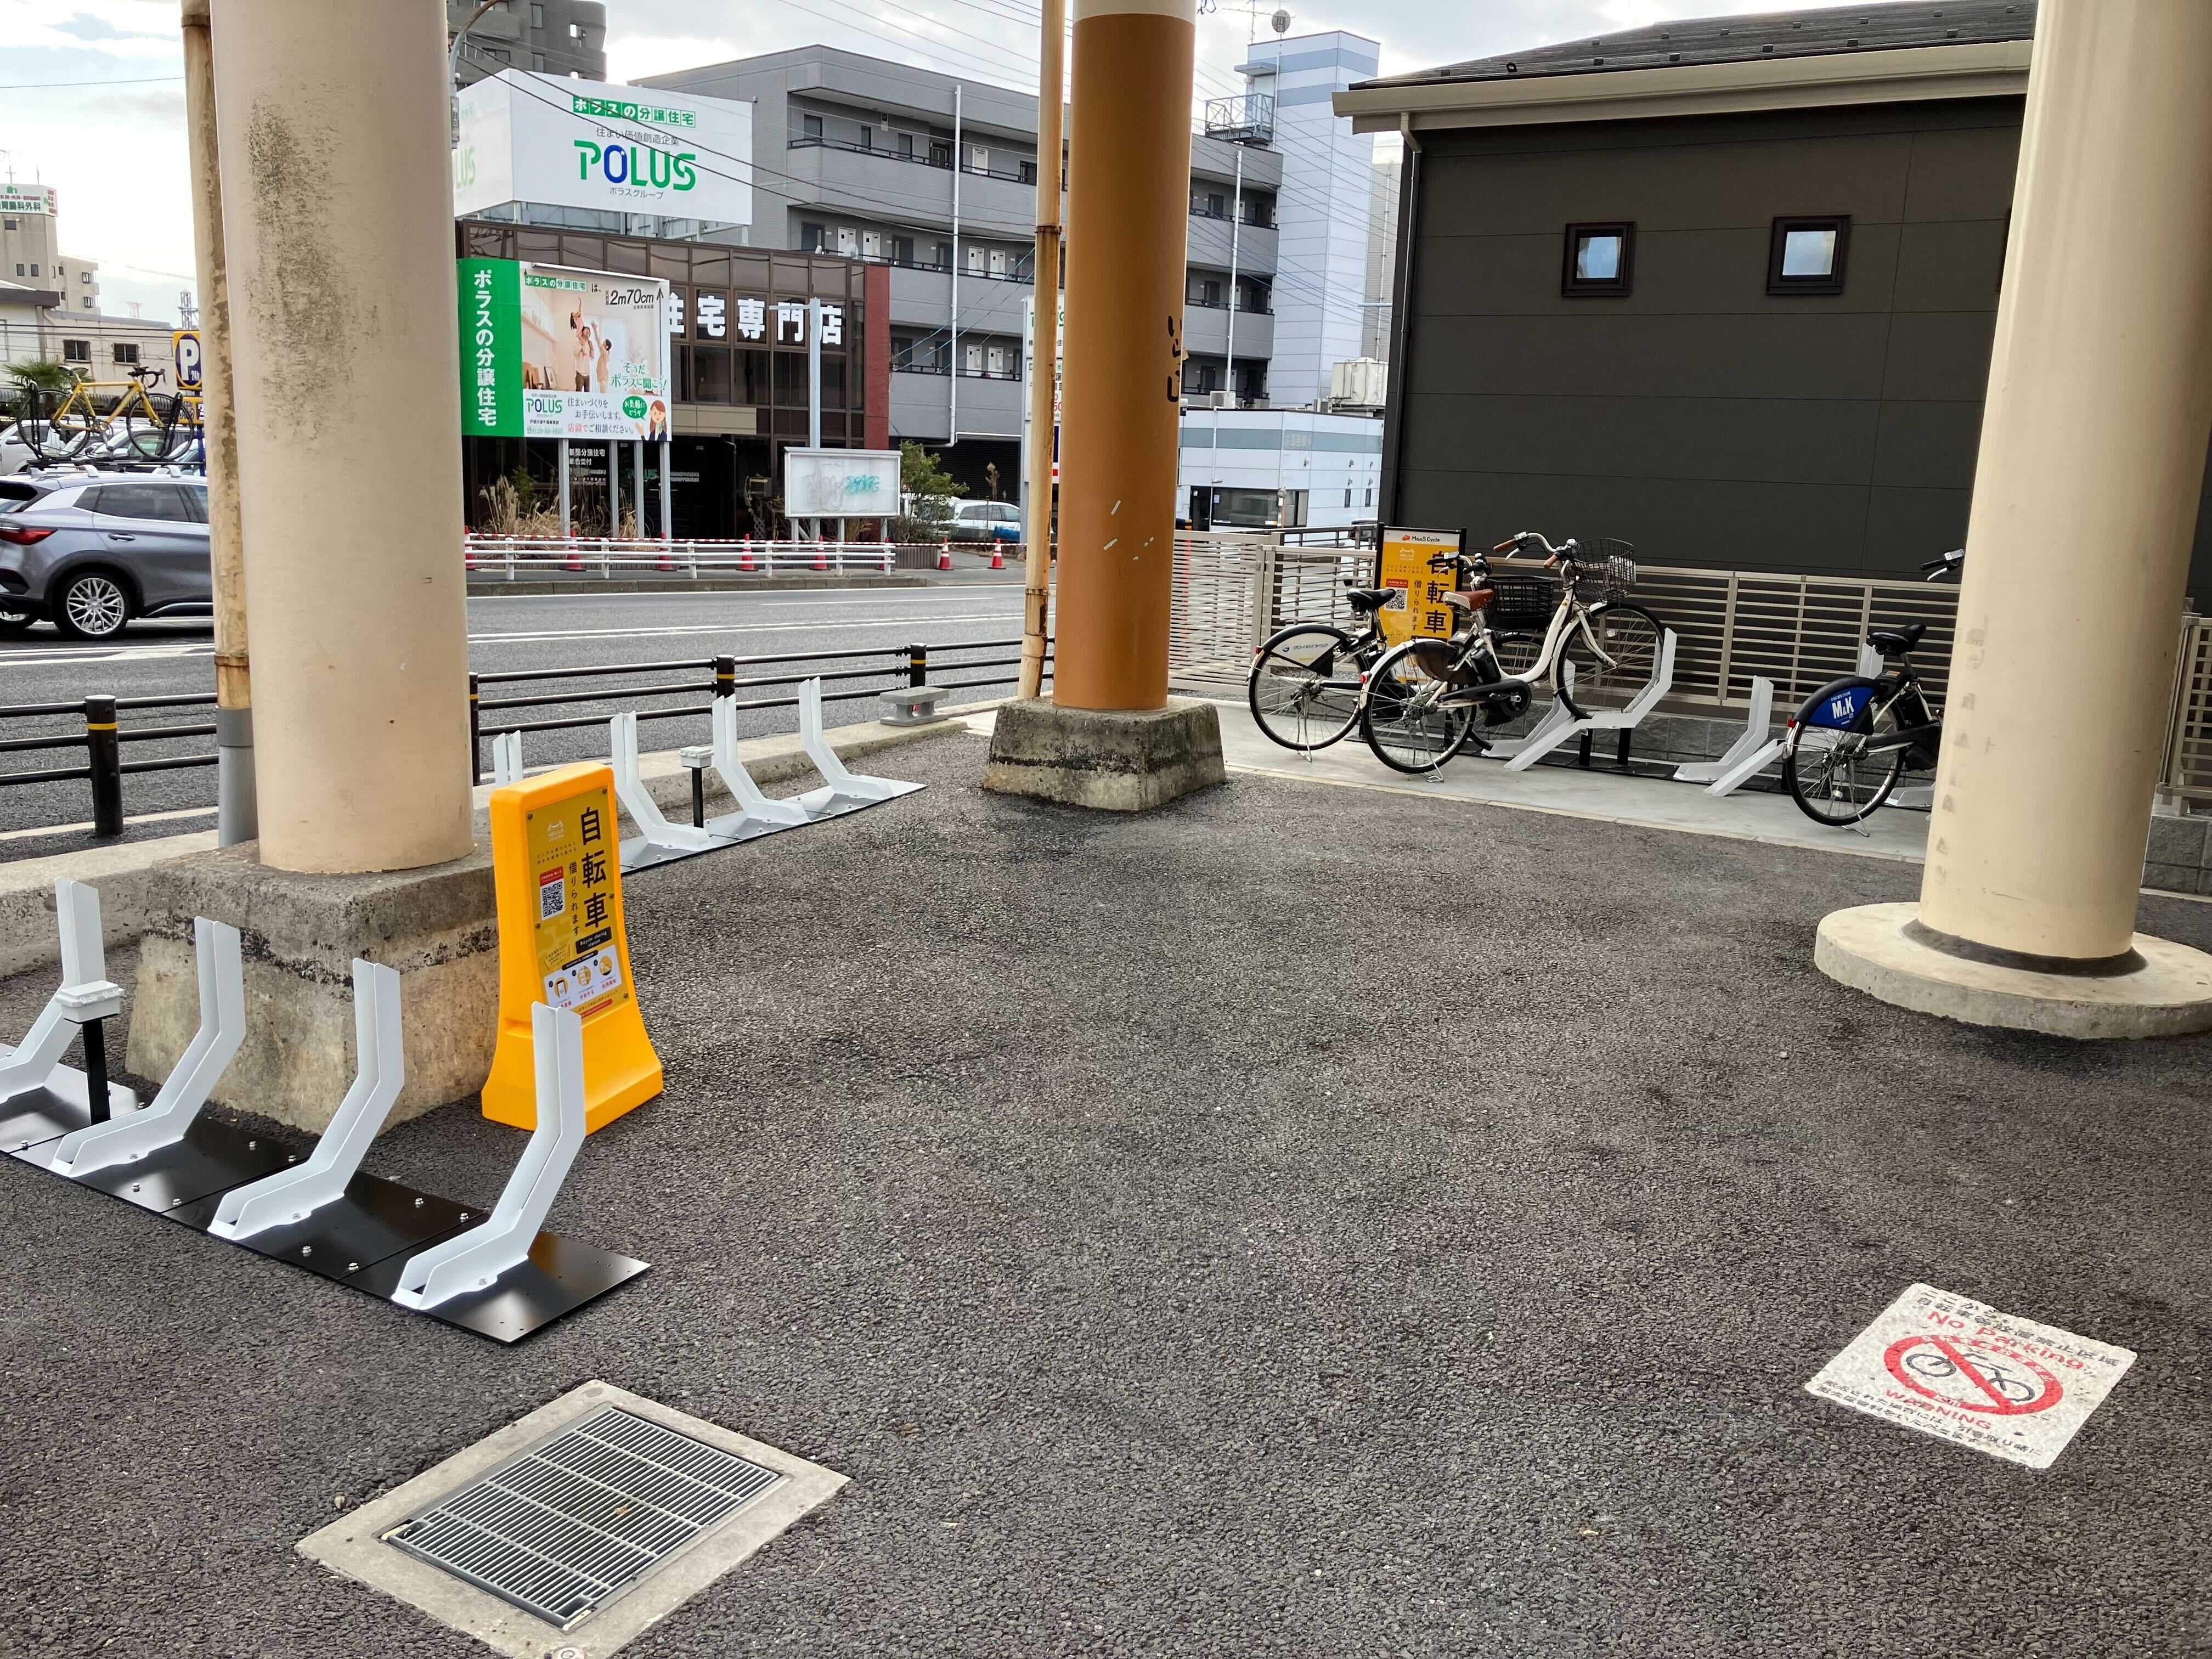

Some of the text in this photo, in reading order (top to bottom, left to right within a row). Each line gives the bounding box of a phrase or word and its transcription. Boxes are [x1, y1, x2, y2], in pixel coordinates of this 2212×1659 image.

[574, 97, 694, 126] ポラスの分譲住宅
[596, 127, 680, 146] 住まい価値創造企業
[574, 140, 696, 191] POLUS
[610, 187, 664, 200] ポラスグループ
[610, 289, 654, 305] 2m70cm
[179, 338, 200, 381] P
[474, 269, 496, 426] ポラスの分譲住宅
[623, 362, 646, 374] そうだ
[526, 398, 562, 413] POLUS
[568, 397, 609, 408] 住まいづくりを
[575, 409, 622, 421] お手伝いします。
[1412, 580, 1423, 631] 借りられます
[580, 806, 609, 928] 自転車
[569, 860, 580, 936] 借りられます
[1927, 1311, 1965, 1329] No
[1976, 1327, 2084, 1370] Parking
